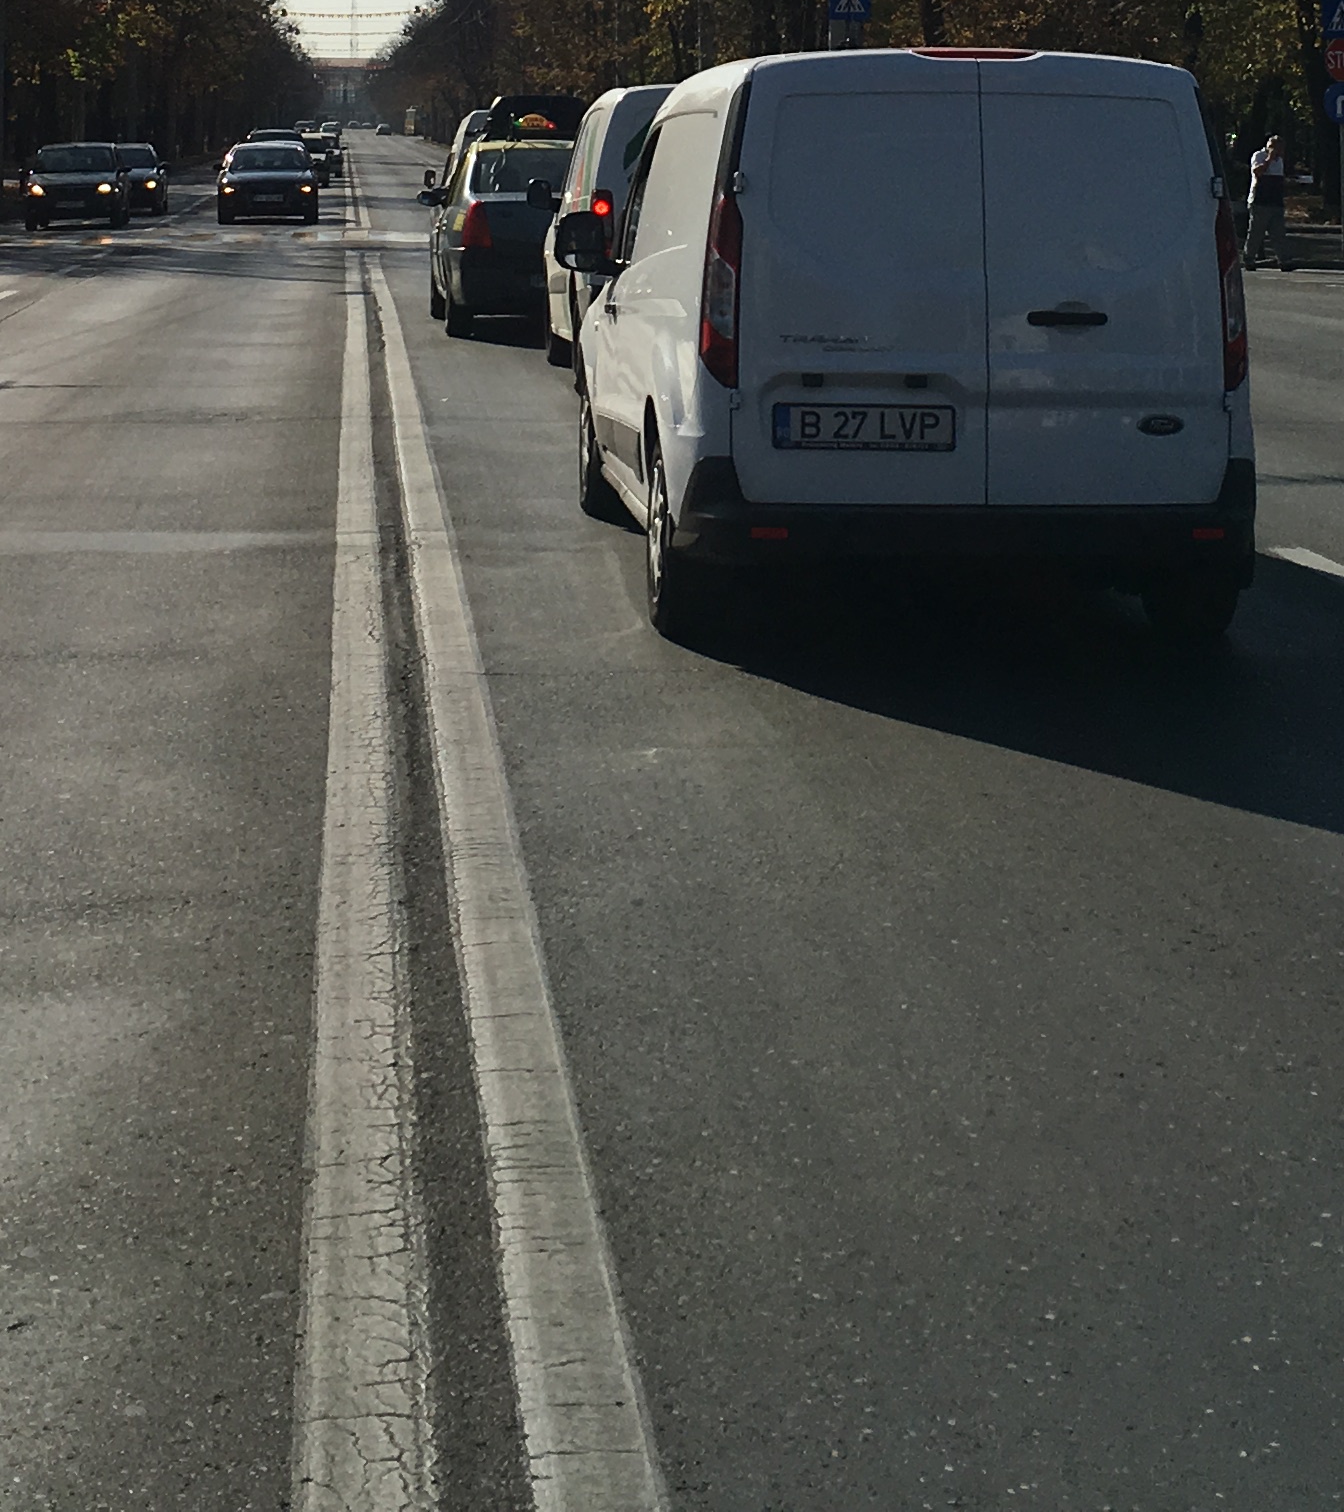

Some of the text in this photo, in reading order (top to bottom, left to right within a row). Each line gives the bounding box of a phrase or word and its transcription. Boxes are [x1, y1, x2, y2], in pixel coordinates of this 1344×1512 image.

[800, 411, 941, 440] B 27 LVP
